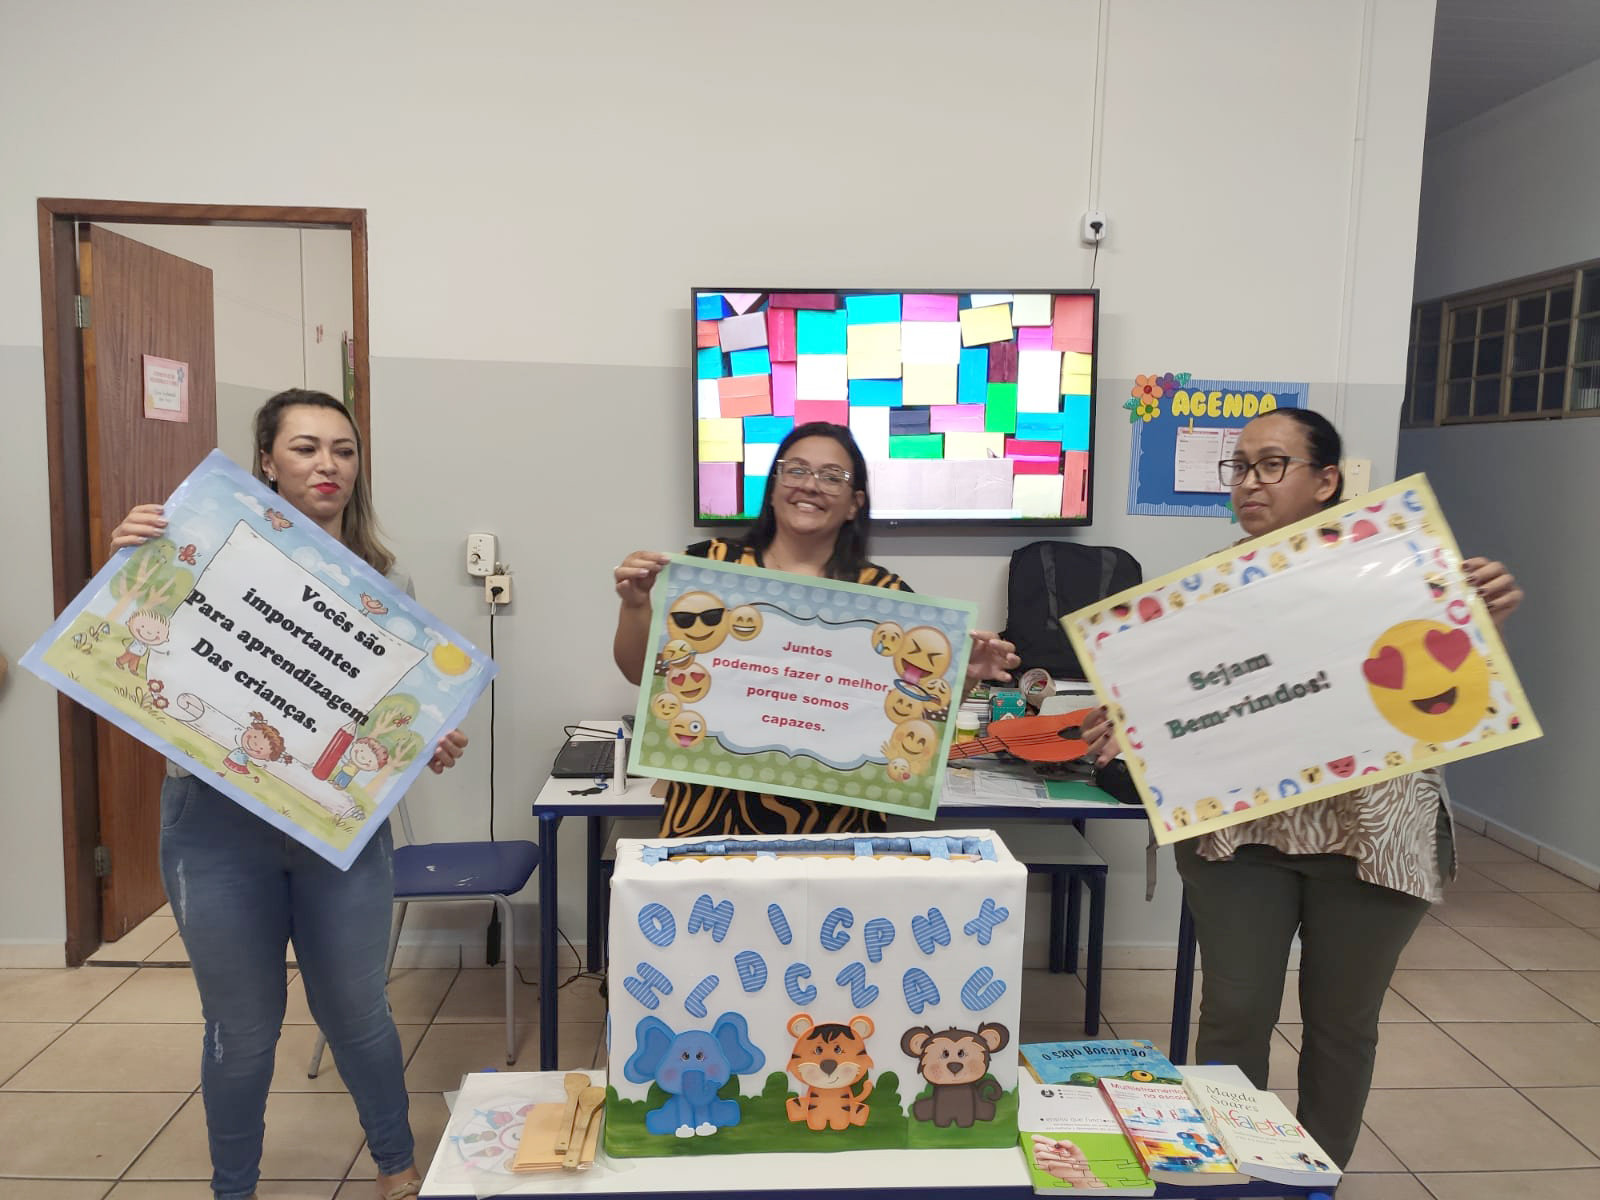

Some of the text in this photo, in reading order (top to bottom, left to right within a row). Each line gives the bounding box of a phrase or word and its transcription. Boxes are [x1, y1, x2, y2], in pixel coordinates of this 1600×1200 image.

[1171, 390, 1278, 418] AGENDA
[242, 588, 361, 679] importantes
[301, 584, 386, 656] Vocês são
[184, 589, 370, 727] Para aprendizagem
[782, 641, 833, 658] Juntos
[191, 637, 317, 733] Das crianças.
[712, 657, 779, 675] podemos
[784, 666, 821, 682] fazer
[825, 674, 834, 683] o
[1188, 653, 1273, 690] Sejam
[747, 686, 849, 711] porque somos
[1165, 670, 1332, 739] Bem-vindos!
[761, 714, 826, 732] capazes.
[638, 903, 677, 947] O
[687, 894, 735, 943] M
[864, 917, 896, 963] P
[963, 898, 1010, 945] X
[623, 962, 674, 1010] H
[684, 974, 720, 1019] L
[734, 950, 768, 993] D
[784, 962, 817, 1006] C
[903, 967, 941, 1014] A
[1052, 1048, 1082, 1059] sapo
[1206, 1085, 1256, 1103] Magda
[1210, 1095, 1259, 1112] Soares
[1210, 1105, 1306, 1139] Alfaletrar
